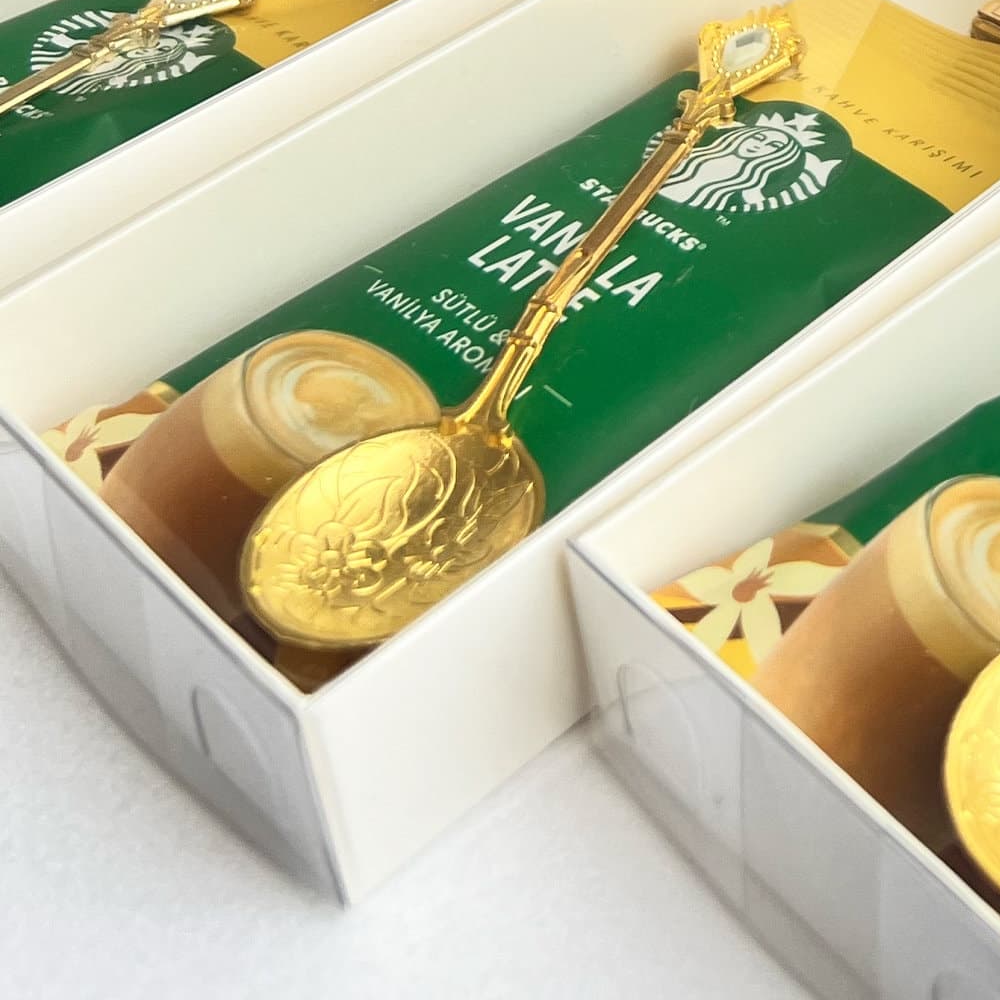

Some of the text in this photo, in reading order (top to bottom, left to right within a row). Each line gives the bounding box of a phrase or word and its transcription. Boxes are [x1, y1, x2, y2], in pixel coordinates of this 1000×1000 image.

[467, 235, 602, 323] LATE
[501, 194, 664, 307] VANLA
[366, 279, 442, 334] VANİLYA
[431, 288, 498, 332] SÜTLÜ
